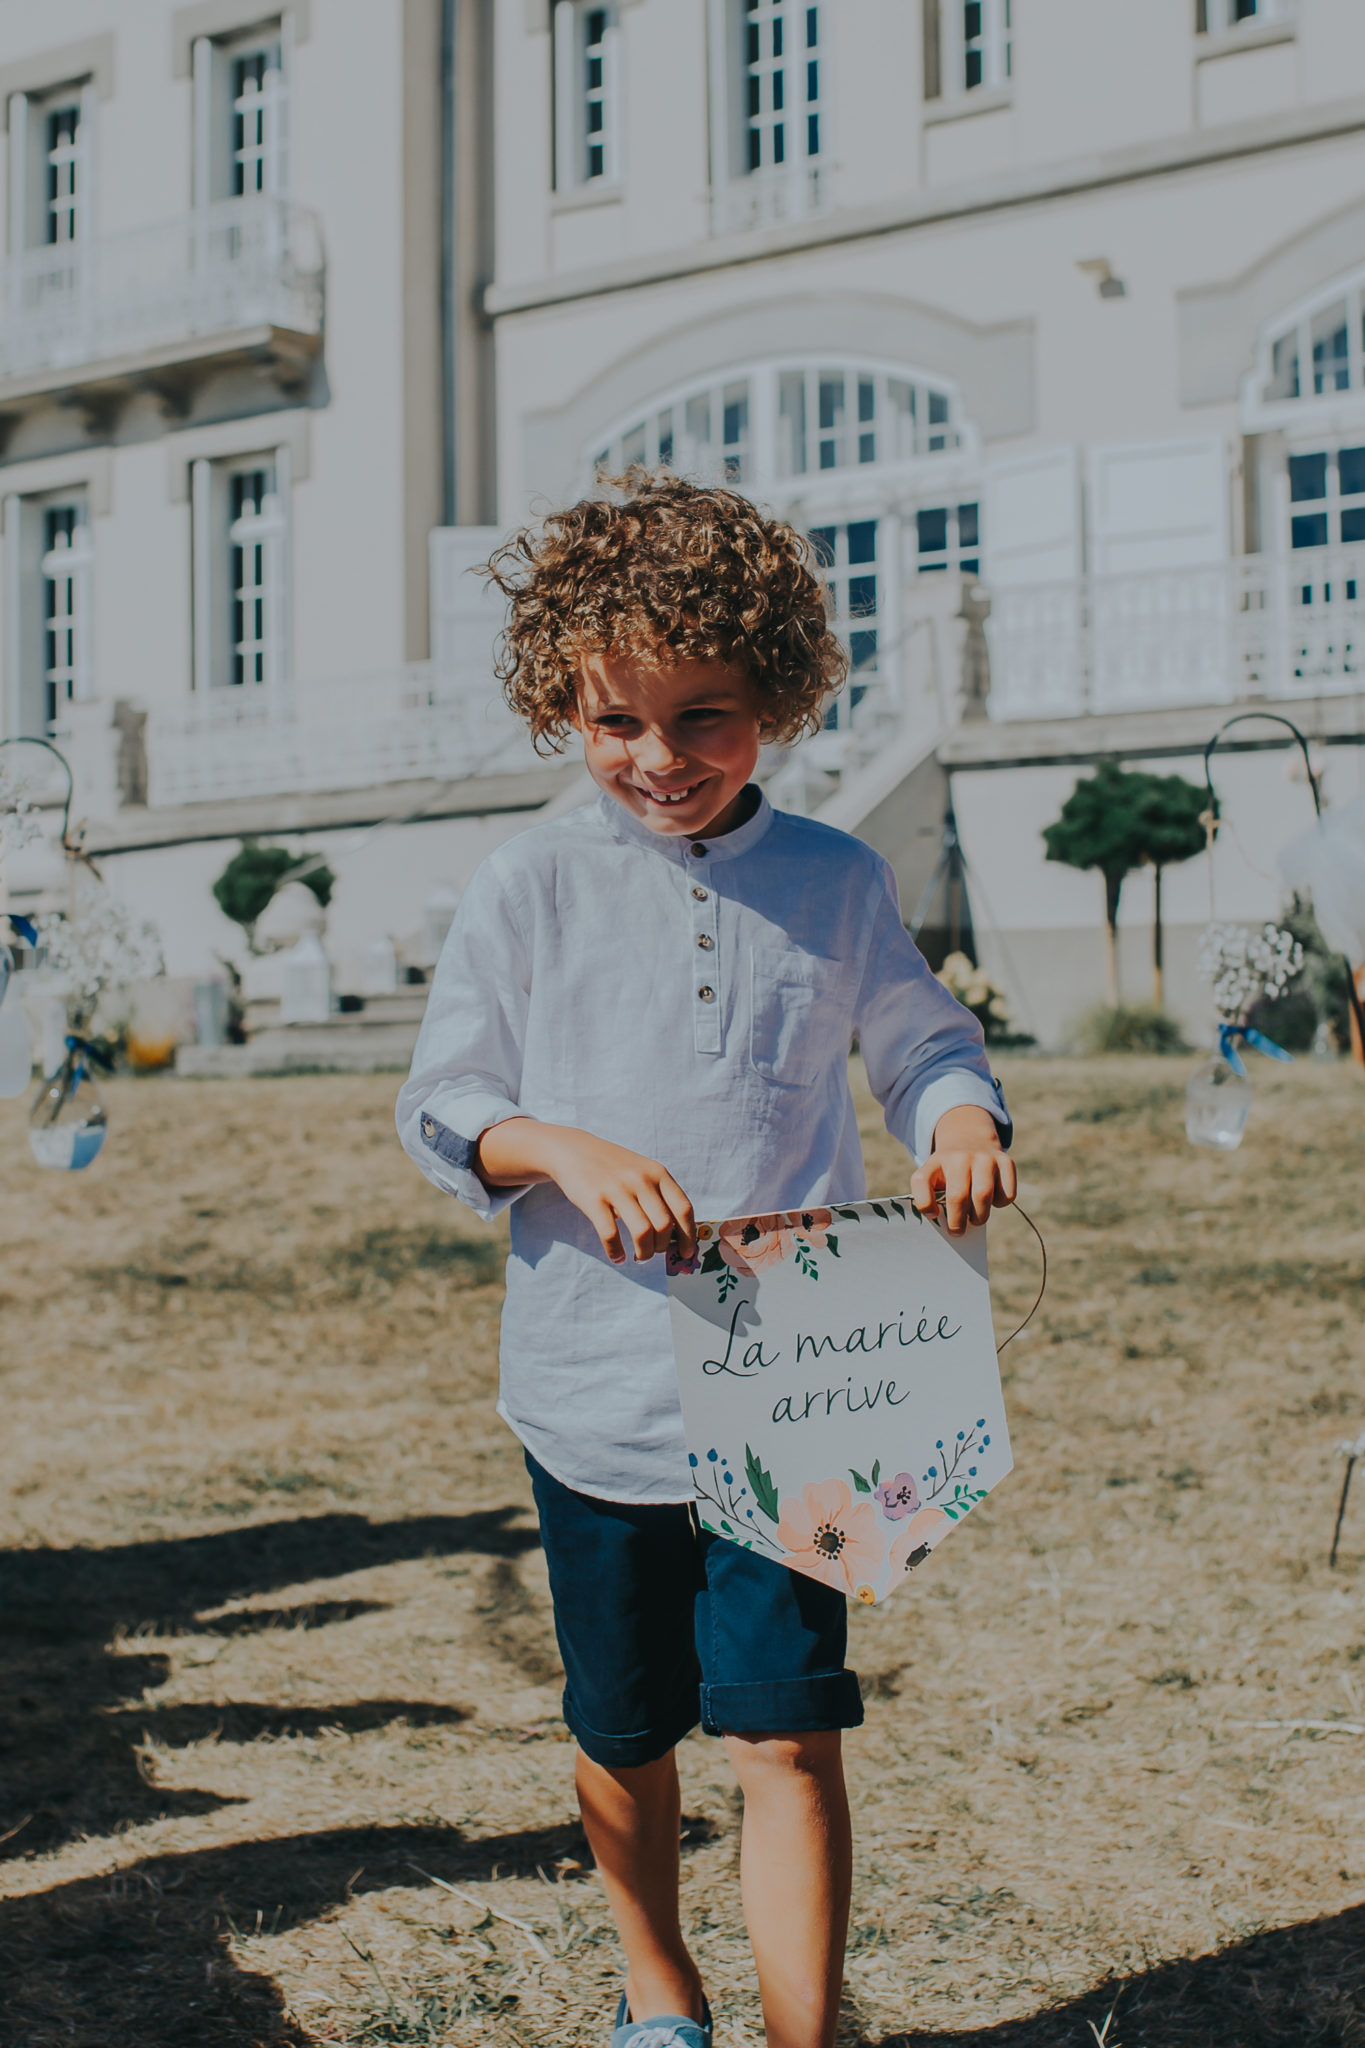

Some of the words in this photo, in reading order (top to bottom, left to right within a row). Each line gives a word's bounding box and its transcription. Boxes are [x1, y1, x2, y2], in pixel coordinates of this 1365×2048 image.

[702, 1299, 781, 1377] La
[795, 1305, 962, 1364] mariée
[771, 1376, 910, 1424] arrive
